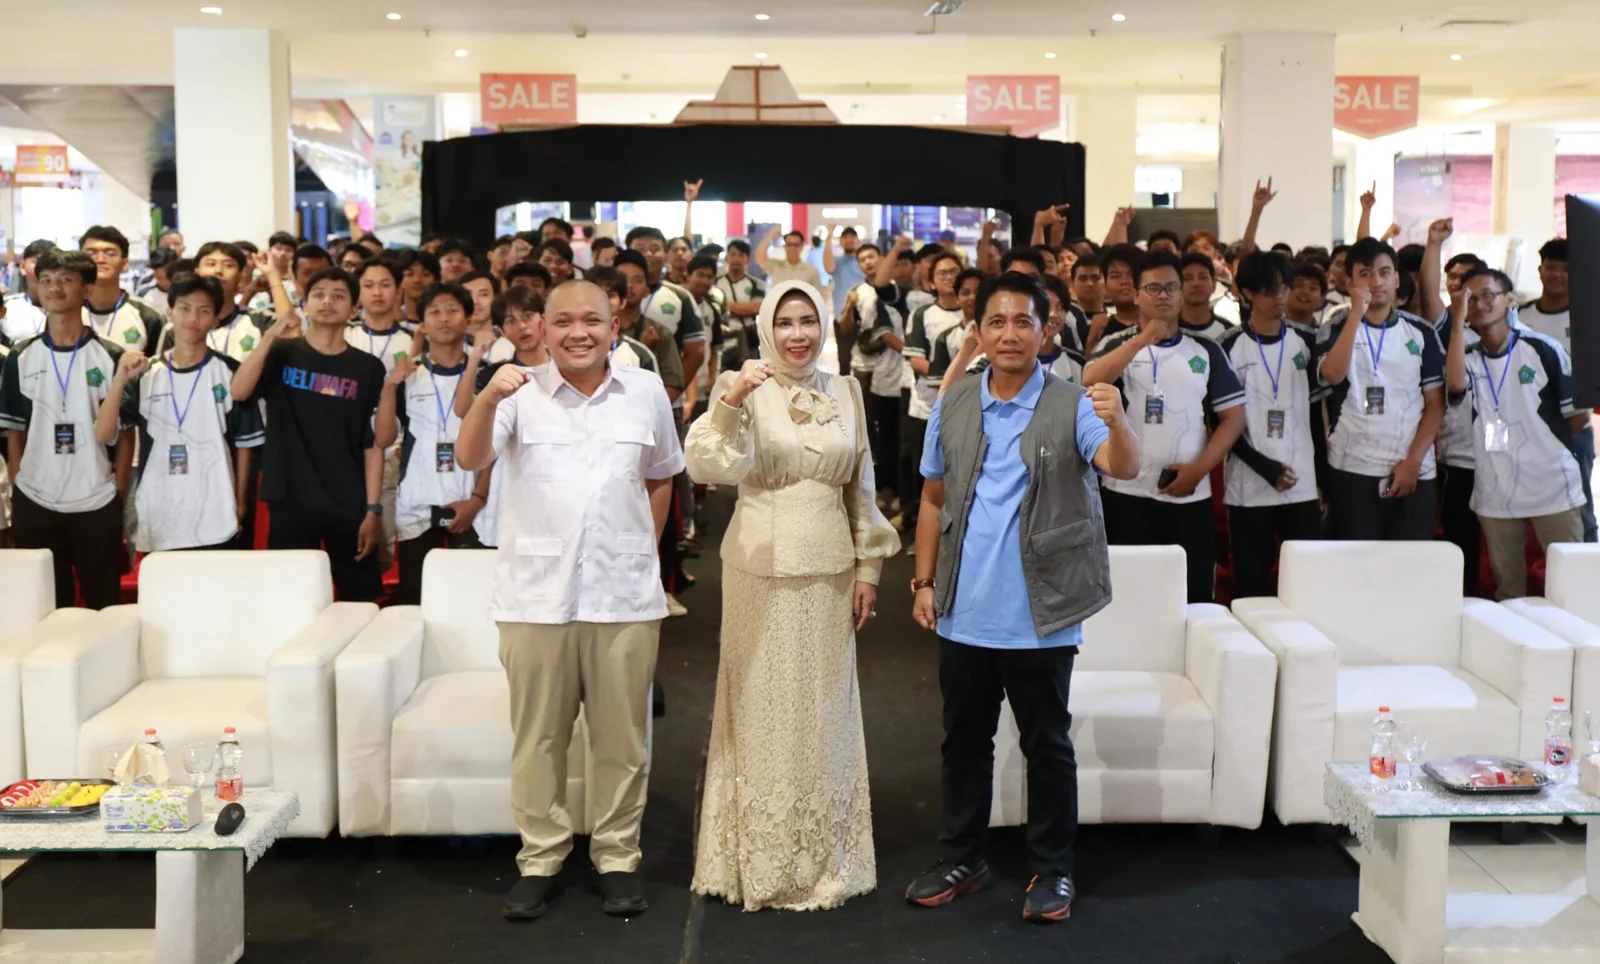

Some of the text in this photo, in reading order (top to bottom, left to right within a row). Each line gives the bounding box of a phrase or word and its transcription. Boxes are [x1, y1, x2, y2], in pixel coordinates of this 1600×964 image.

[487, 82, 569, 110] SALE
[974, 83, 1053, 111] SALE
[1333, 82, 1412, 110] SALE
[44, 154, 65, 173] 90
